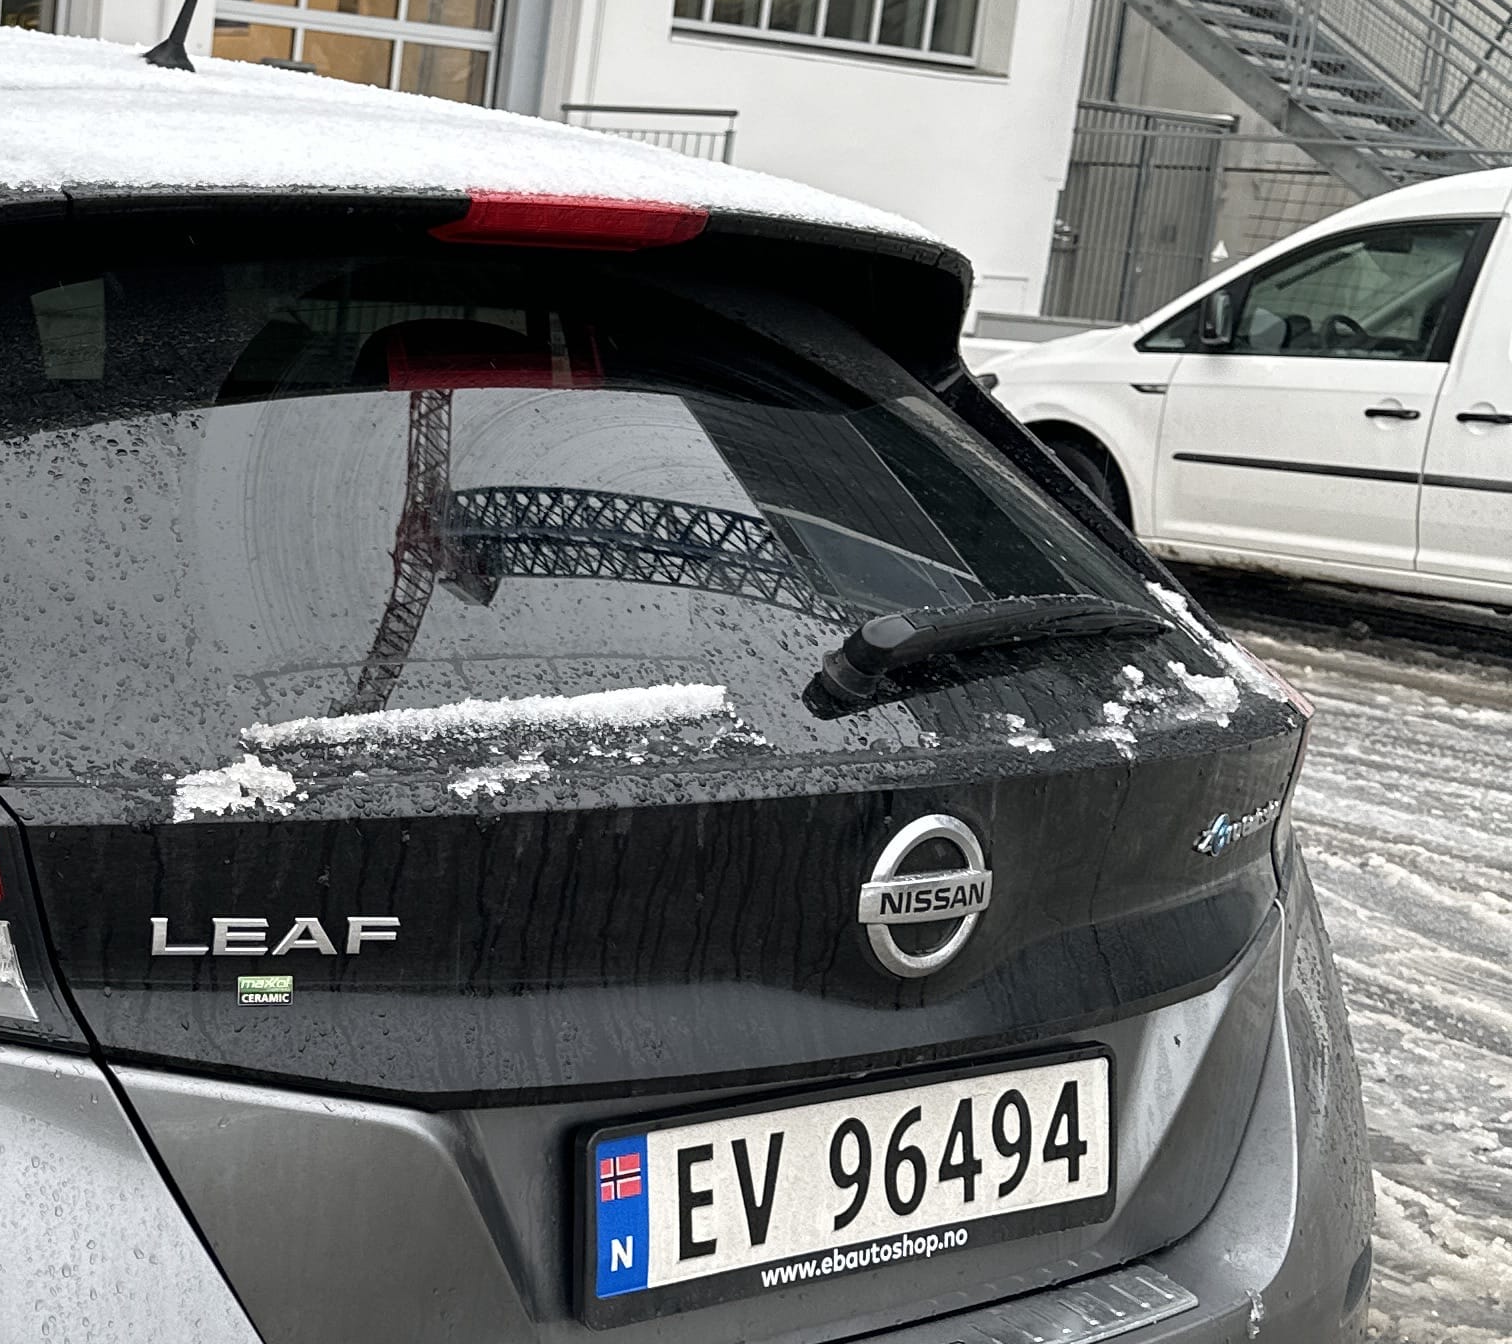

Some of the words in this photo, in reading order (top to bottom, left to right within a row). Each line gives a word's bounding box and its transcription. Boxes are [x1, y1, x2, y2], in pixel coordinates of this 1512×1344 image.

[880, 881, 985, 915] NISSAN
[150, 916, 401, 956] LEAF
[241, 993, 290, 1003] CERAMIC
[677, 1131, 785, 1261] EV
[828, 1080, 1088, 1232] 96494
[610, 1235, 634, 1272] N
[761, 1227, 969, 1288] www.ebautoshop.no
